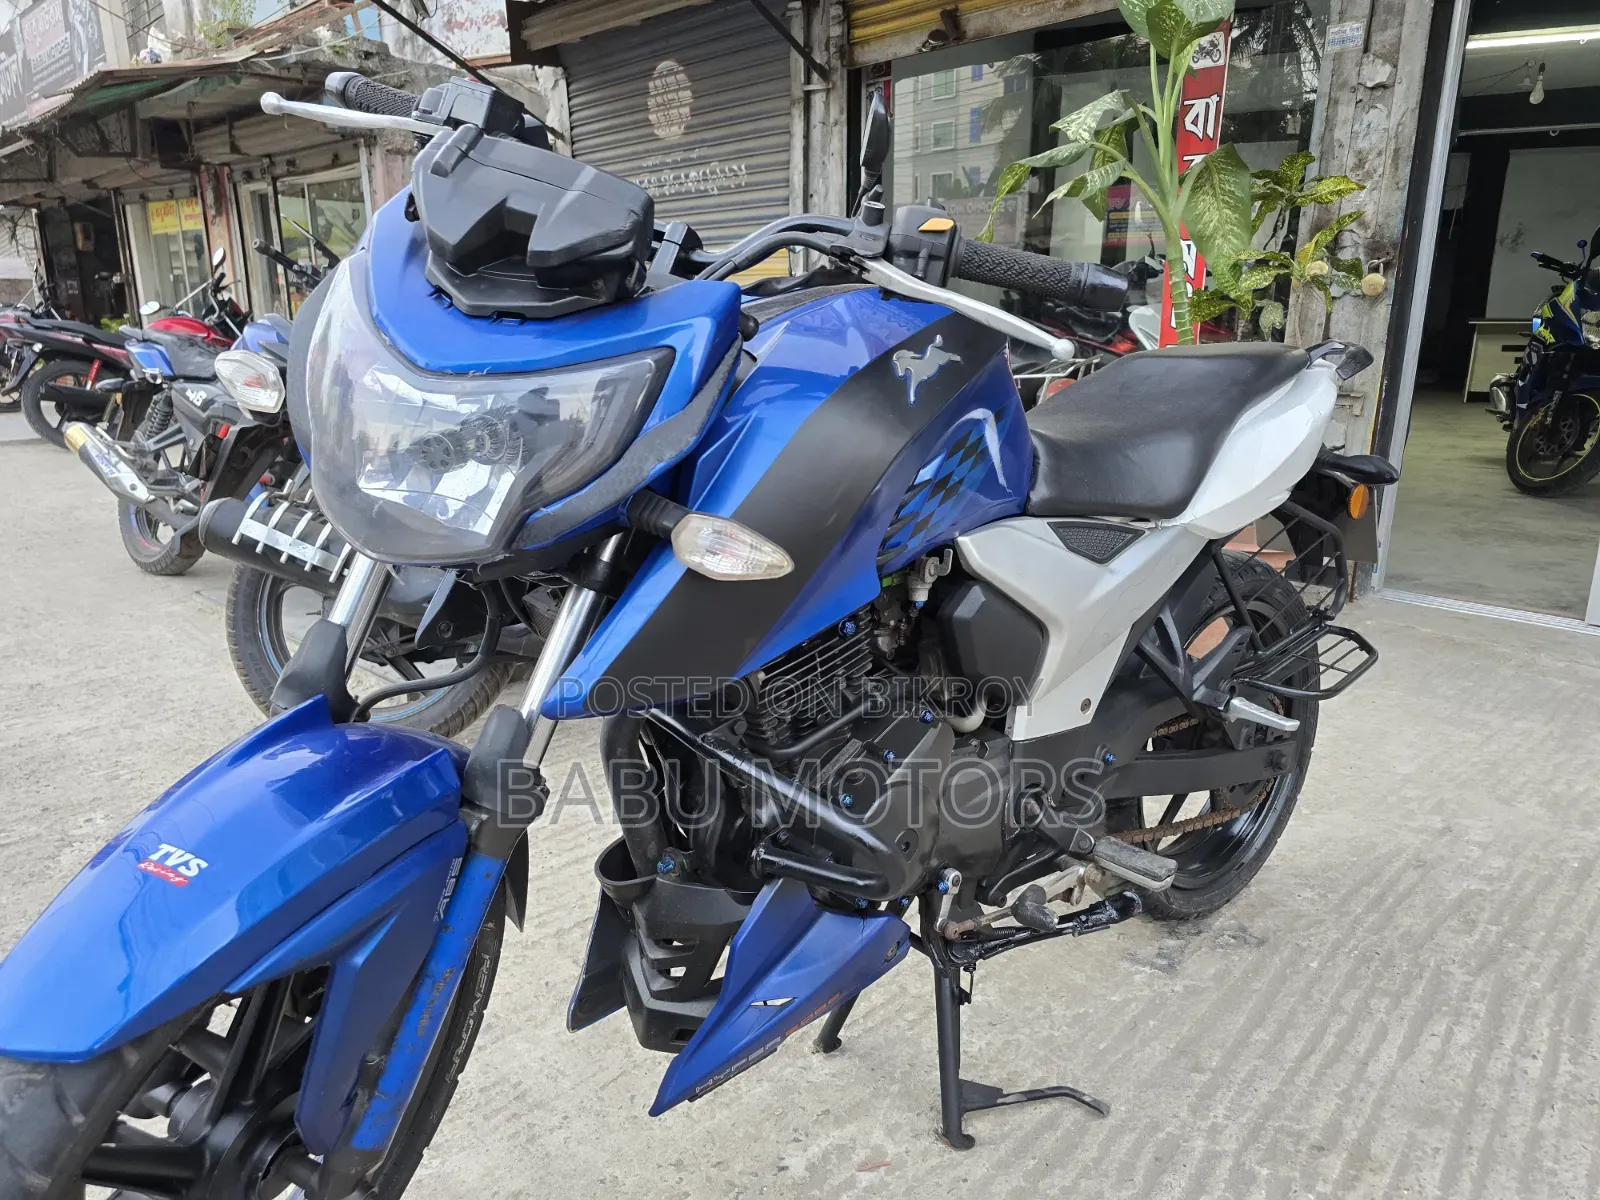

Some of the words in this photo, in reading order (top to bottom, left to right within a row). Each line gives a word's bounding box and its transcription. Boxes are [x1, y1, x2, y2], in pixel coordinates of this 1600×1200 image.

[148, 843, 209, 877] TVS
[439, 857, 463, 920] ABS
[695, 1036, 781, 1093] HYPER
